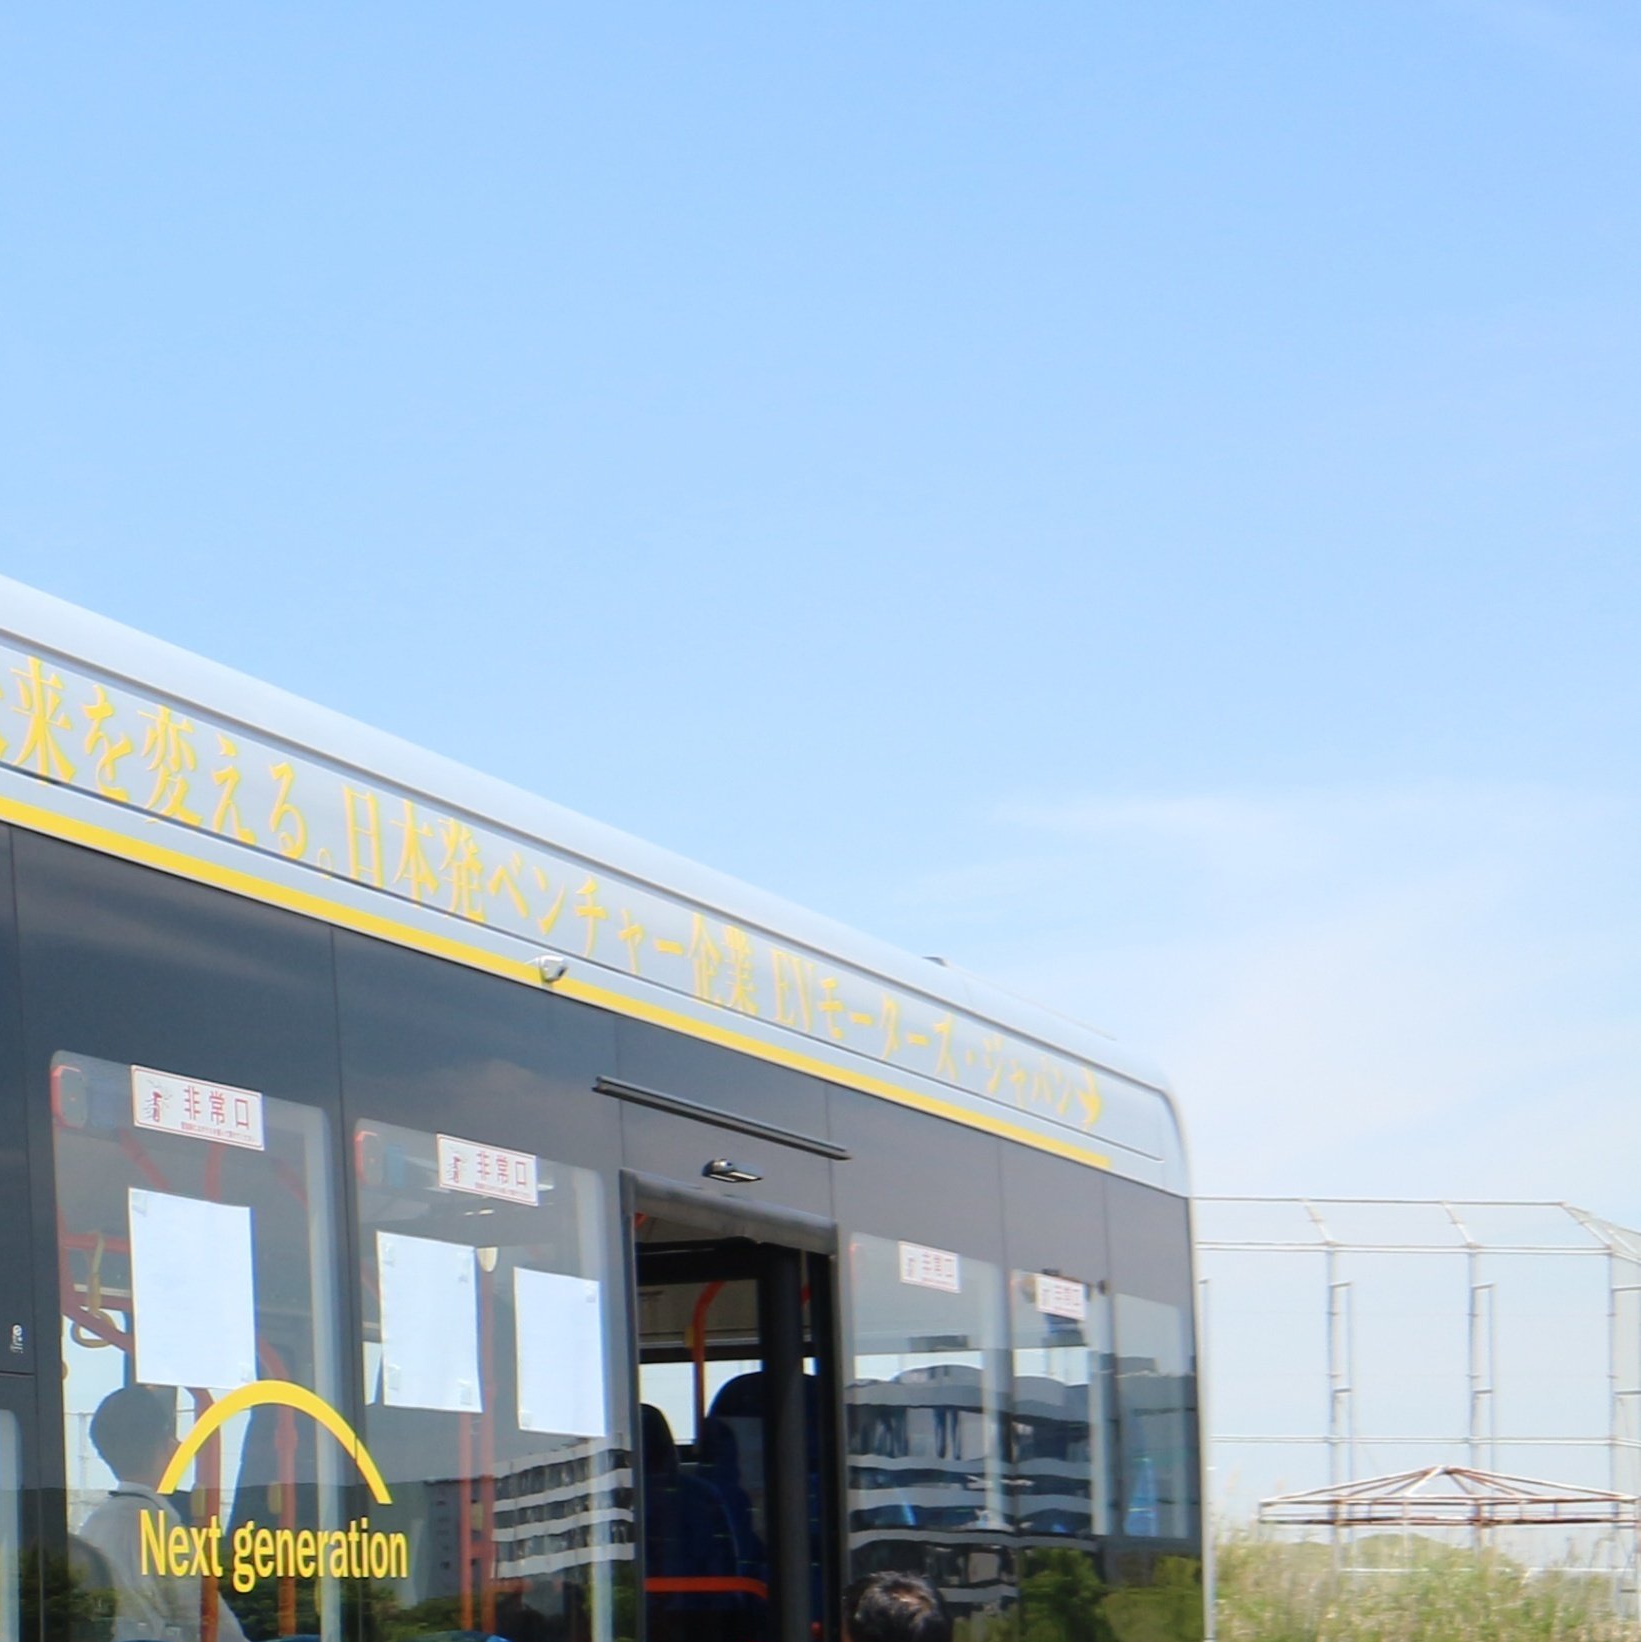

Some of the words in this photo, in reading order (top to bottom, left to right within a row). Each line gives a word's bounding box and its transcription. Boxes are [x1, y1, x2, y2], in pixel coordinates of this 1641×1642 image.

[184, 1085, 250, 1130] 非常口
[139, 1508, 224, 1578] Next
[232, 1516, 408, 1593] generation
